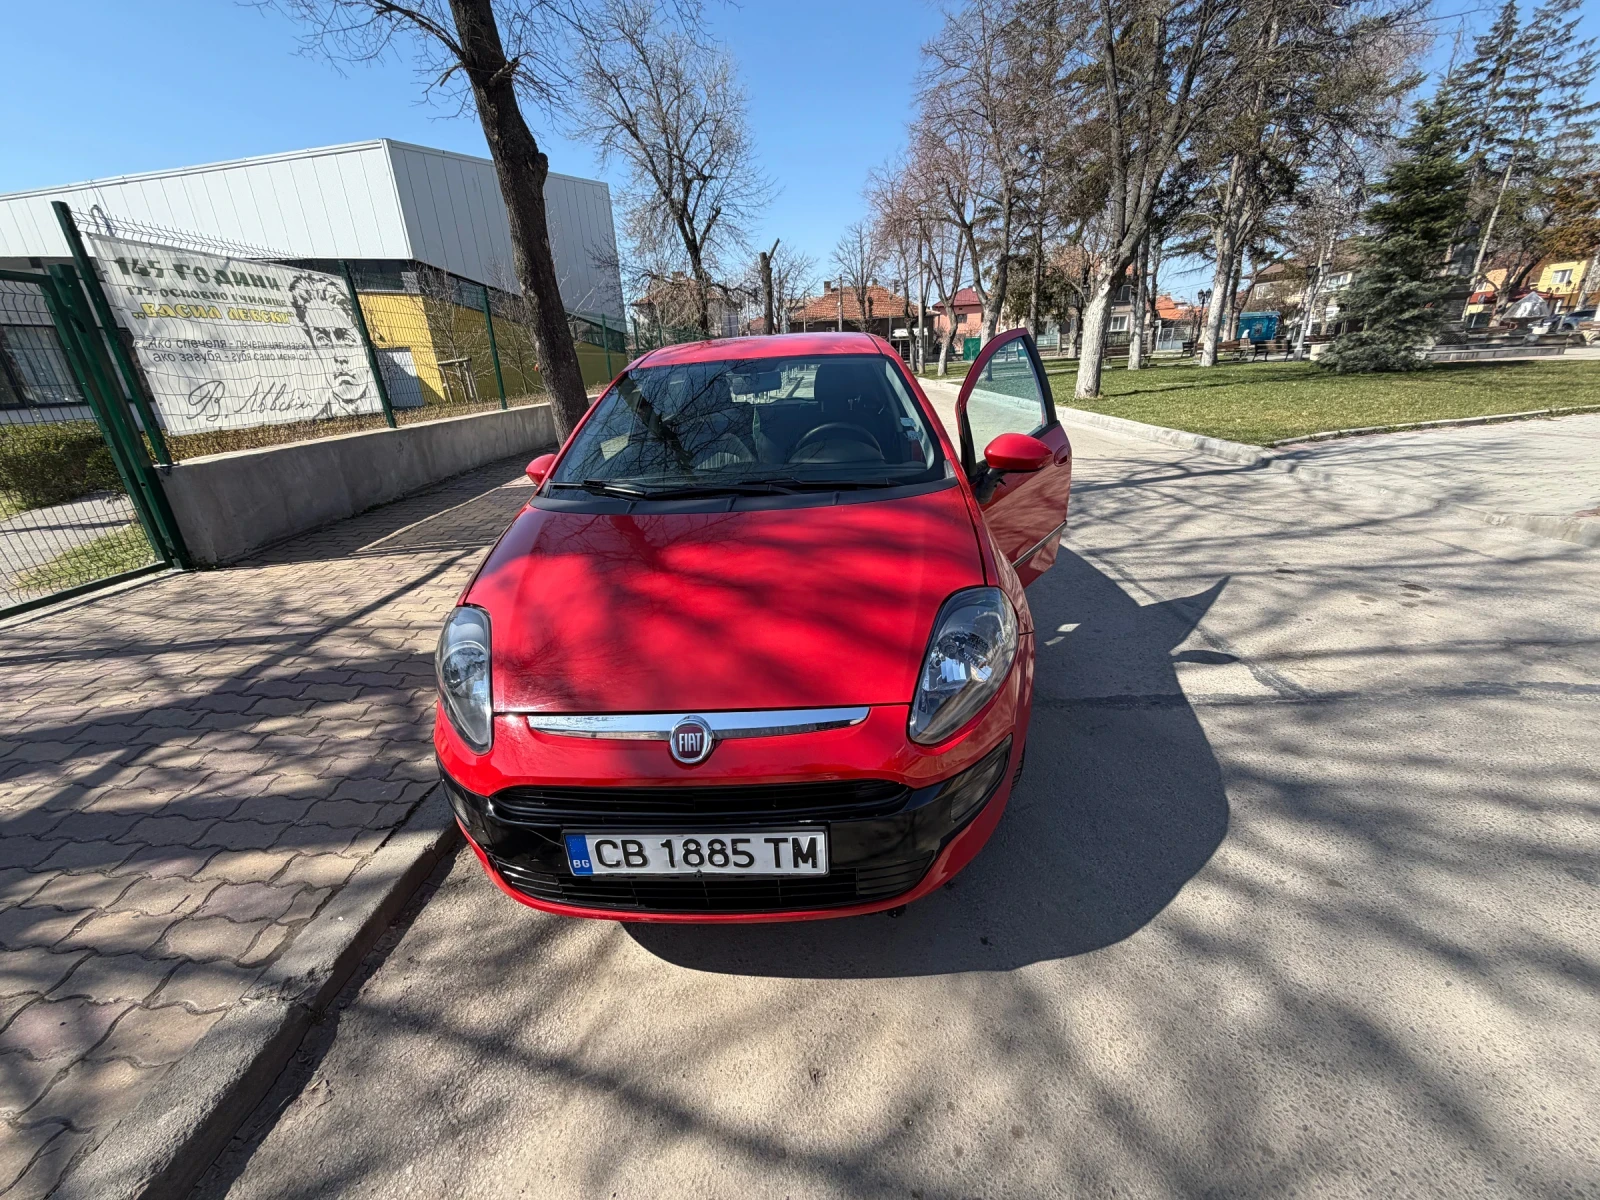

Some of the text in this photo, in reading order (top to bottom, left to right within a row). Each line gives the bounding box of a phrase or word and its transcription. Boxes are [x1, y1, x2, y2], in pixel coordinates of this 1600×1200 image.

[114, 257, 281, 291] 145 ГОДИНИ
[160, 288, 228, 301] ОСНОВНО
[153, 352, 176, 362] ако
[678, 732, 703, 752] FIAT
[594, 837, 818, 869] CB 1885 TM
[573, 859, 590, 868] BG
